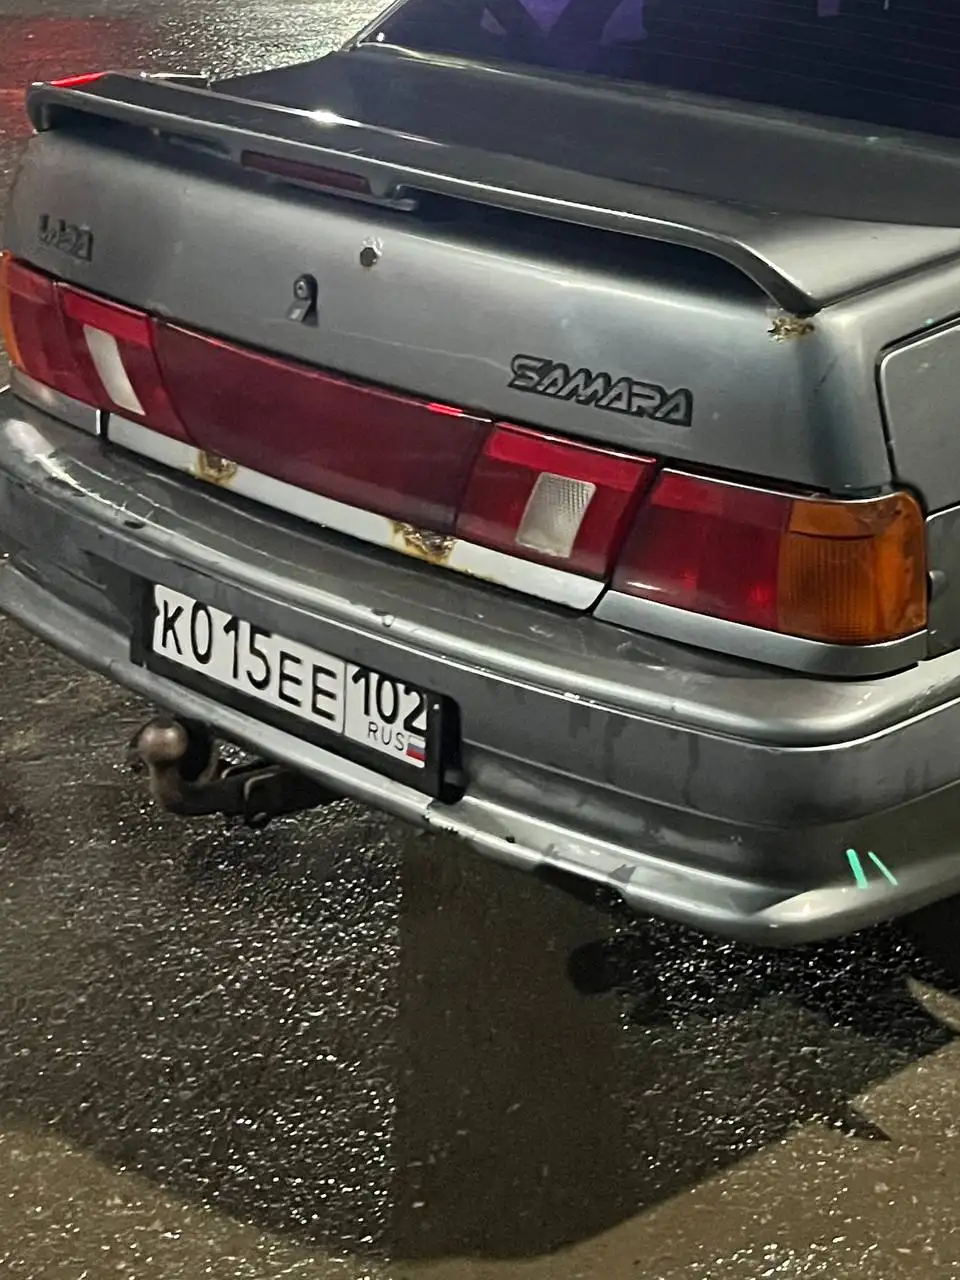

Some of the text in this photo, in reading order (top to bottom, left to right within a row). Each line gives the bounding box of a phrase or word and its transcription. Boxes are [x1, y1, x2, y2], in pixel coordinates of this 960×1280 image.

[507, 353, 694, 428] SAMARA
[351, 666, 429, 737] 102
[367, 721, 405, 752] RUS
